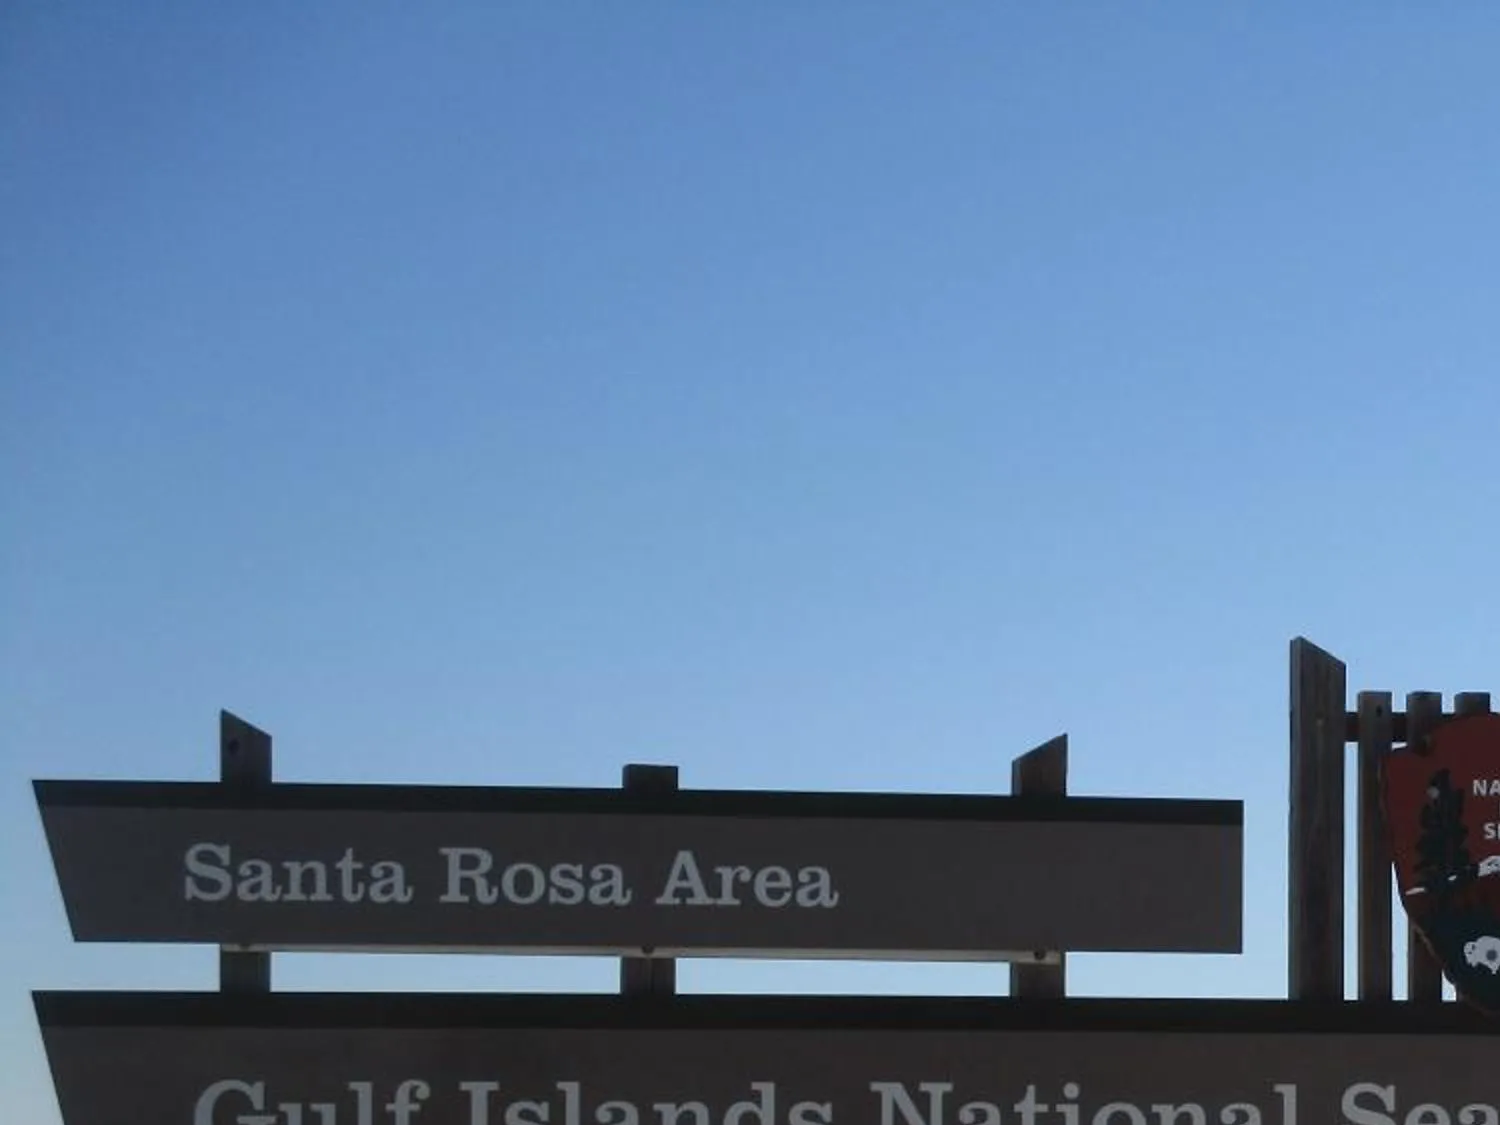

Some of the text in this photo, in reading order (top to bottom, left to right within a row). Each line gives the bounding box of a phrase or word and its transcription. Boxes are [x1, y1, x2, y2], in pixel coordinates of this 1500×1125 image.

[184, 842, 840, 909] Santa Rosa Area
